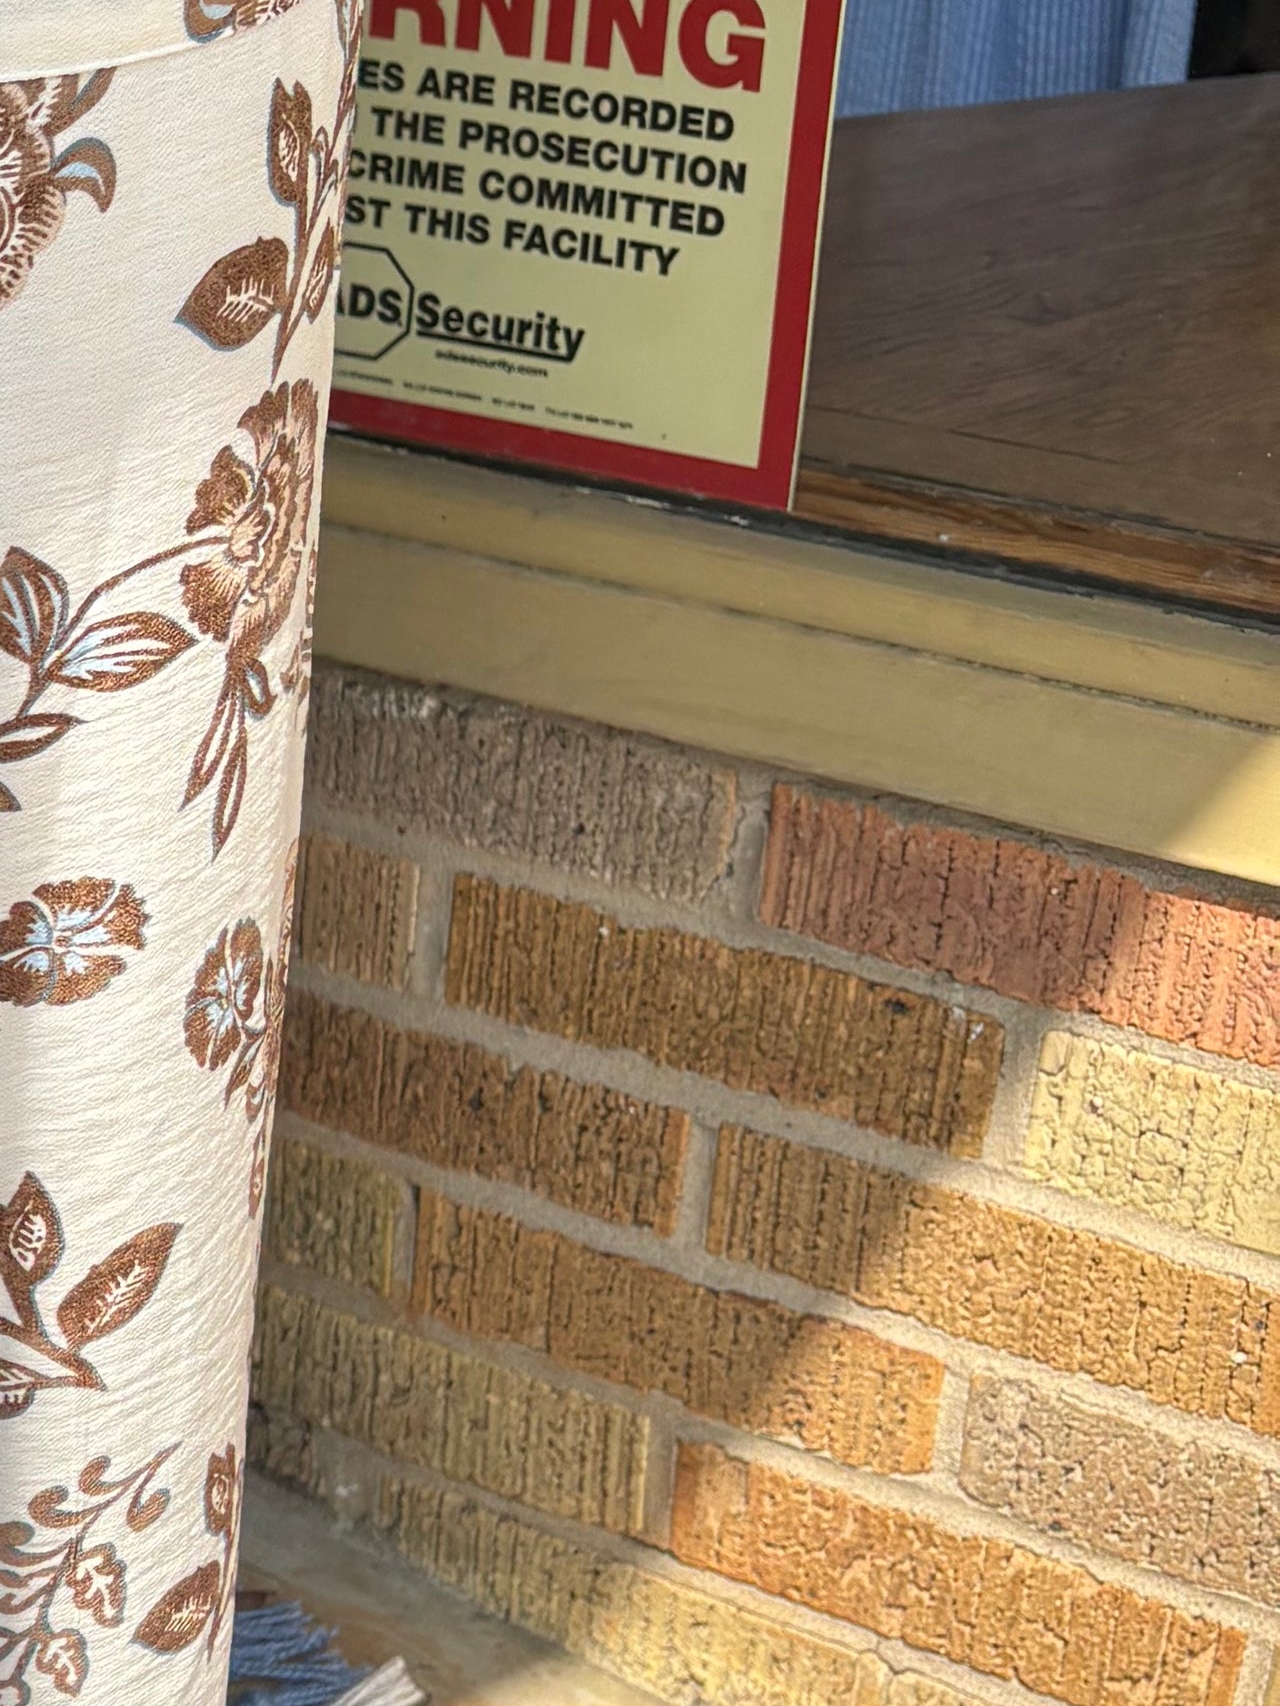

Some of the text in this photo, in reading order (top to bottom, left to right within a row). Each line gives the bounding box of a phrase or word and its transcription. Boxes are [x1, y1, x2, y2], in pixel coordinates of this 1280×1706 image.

[357, 57, 735, 142] ES ARE RECORDED
[348, 148, 725, 238] CRIME COMMITTED
[371, 106, 747, 195] THE PROSECUTION
[344, 194, 681, 278] ST THIS FACILITY
[415, 290, 586, 364] Security
